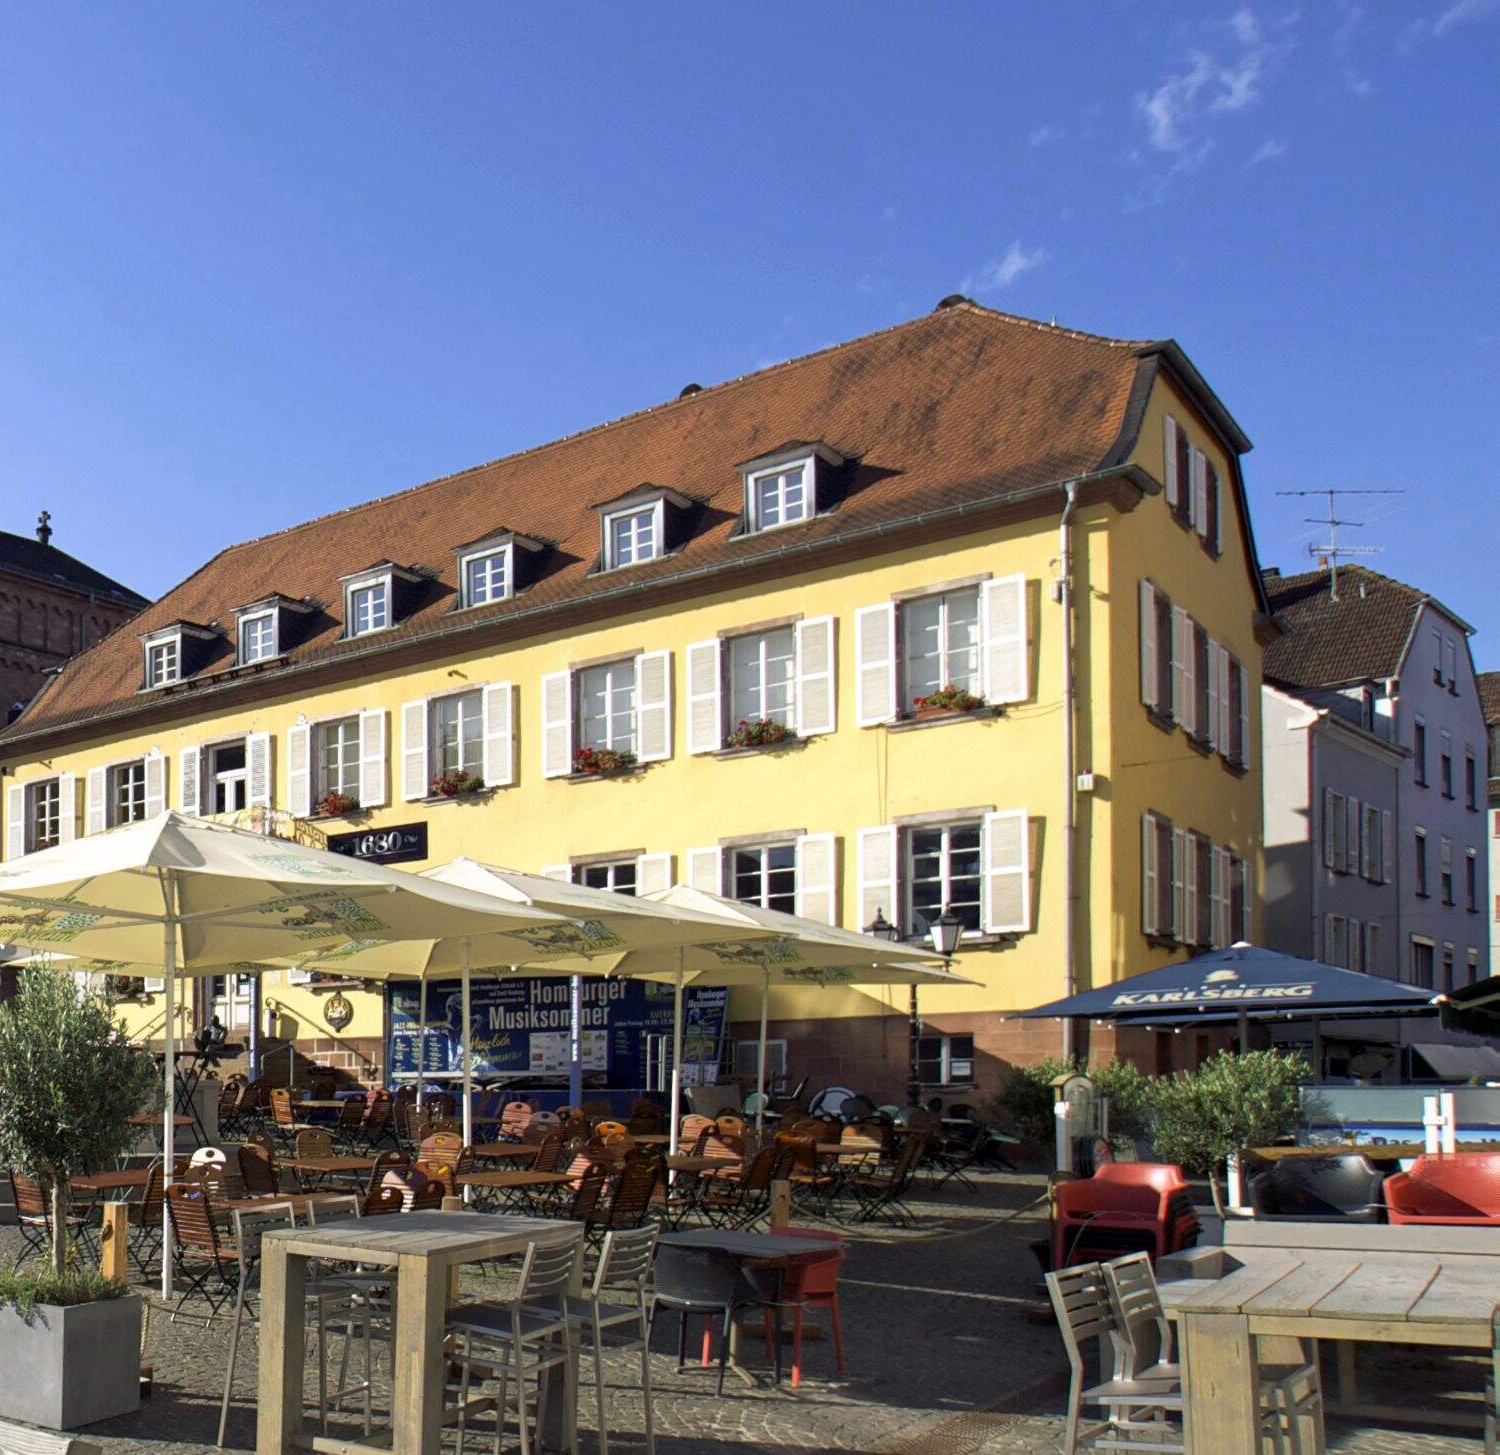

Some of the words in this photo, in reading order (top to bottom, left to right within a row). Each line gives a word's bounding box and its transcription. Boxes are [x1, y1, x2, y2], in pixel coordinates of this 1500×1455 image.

[352, 831, 402, 856] 1680
[530, 980, 626, 1006] Homurger
[1112, 985, 1314, 1006] KARLSBERG
